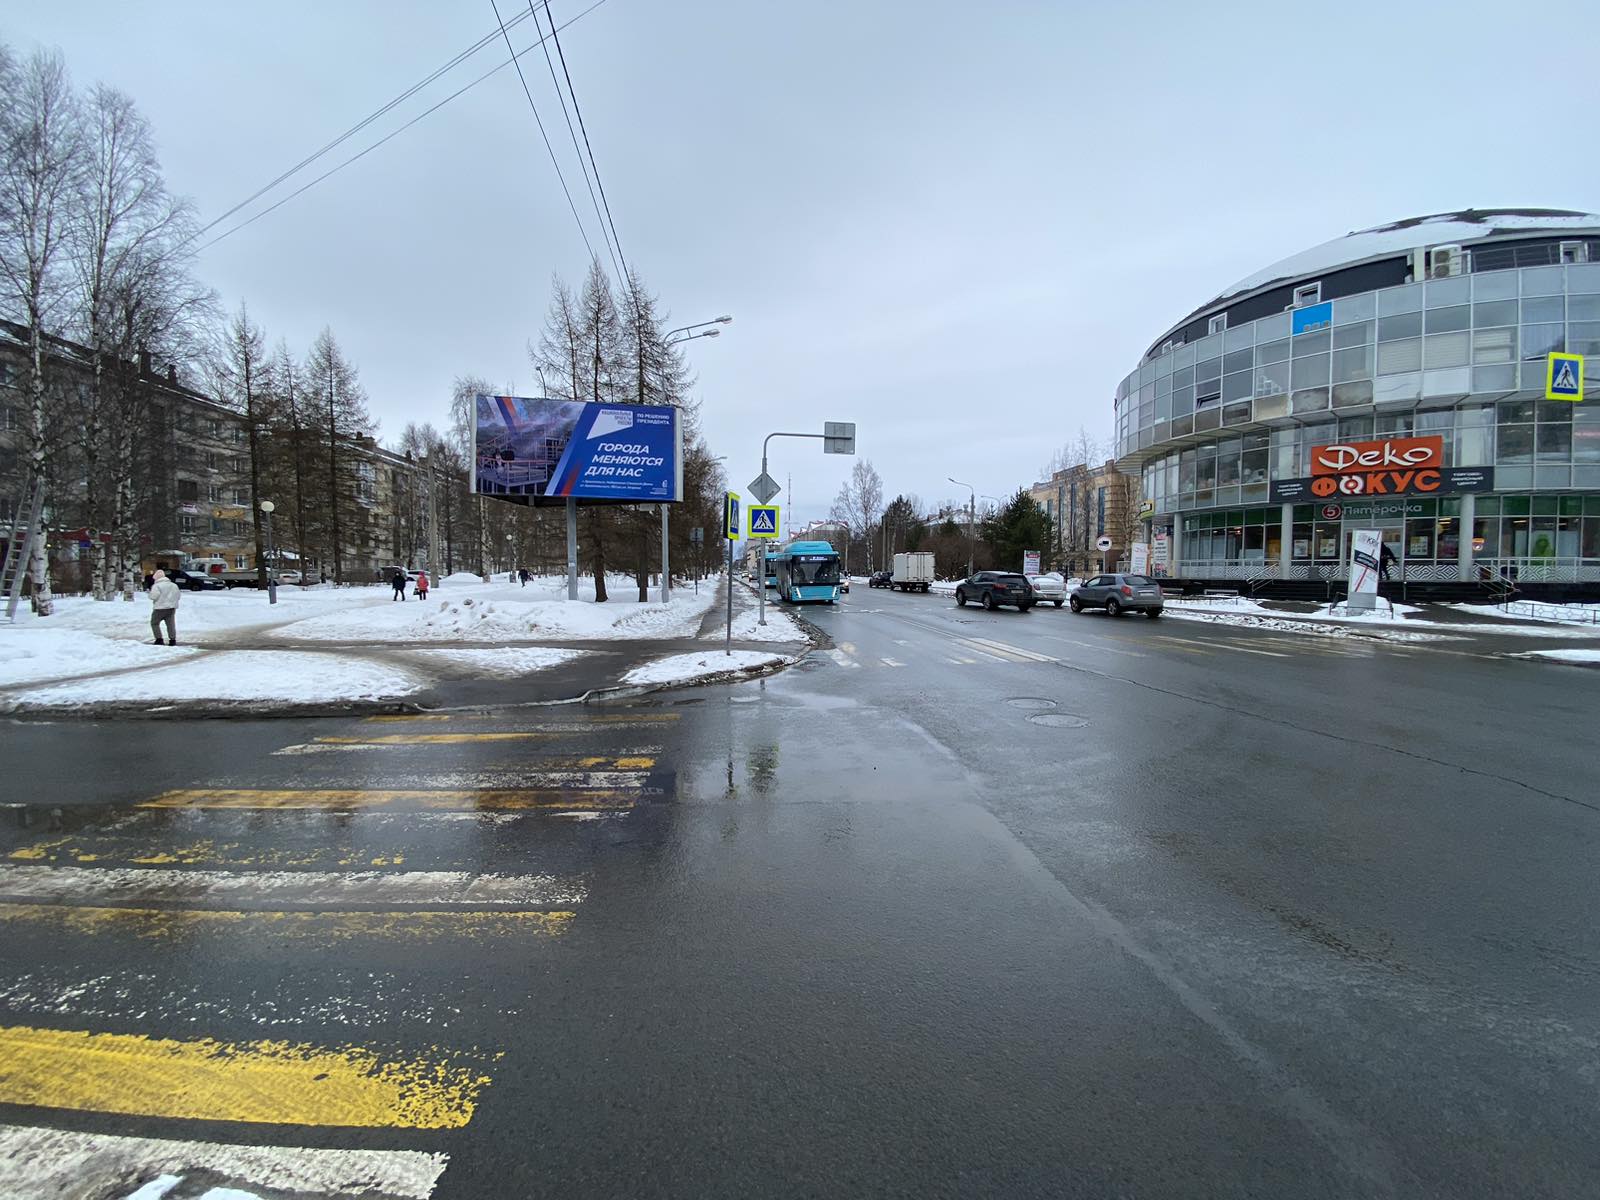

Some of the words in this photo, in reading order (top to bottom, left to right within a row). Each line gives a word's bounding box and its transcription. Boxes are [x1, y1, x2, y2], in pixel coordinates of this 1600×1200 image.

[597, 442, 649, 454] ГОРОДА
[591, 454, 664, 467] МЕНЯЮТСЯ
[584, 466, 615, 477] ДЛЯ
[615, 467, 644, 477] НАС
[1311, 470, 1441, 497] ФОКУС
